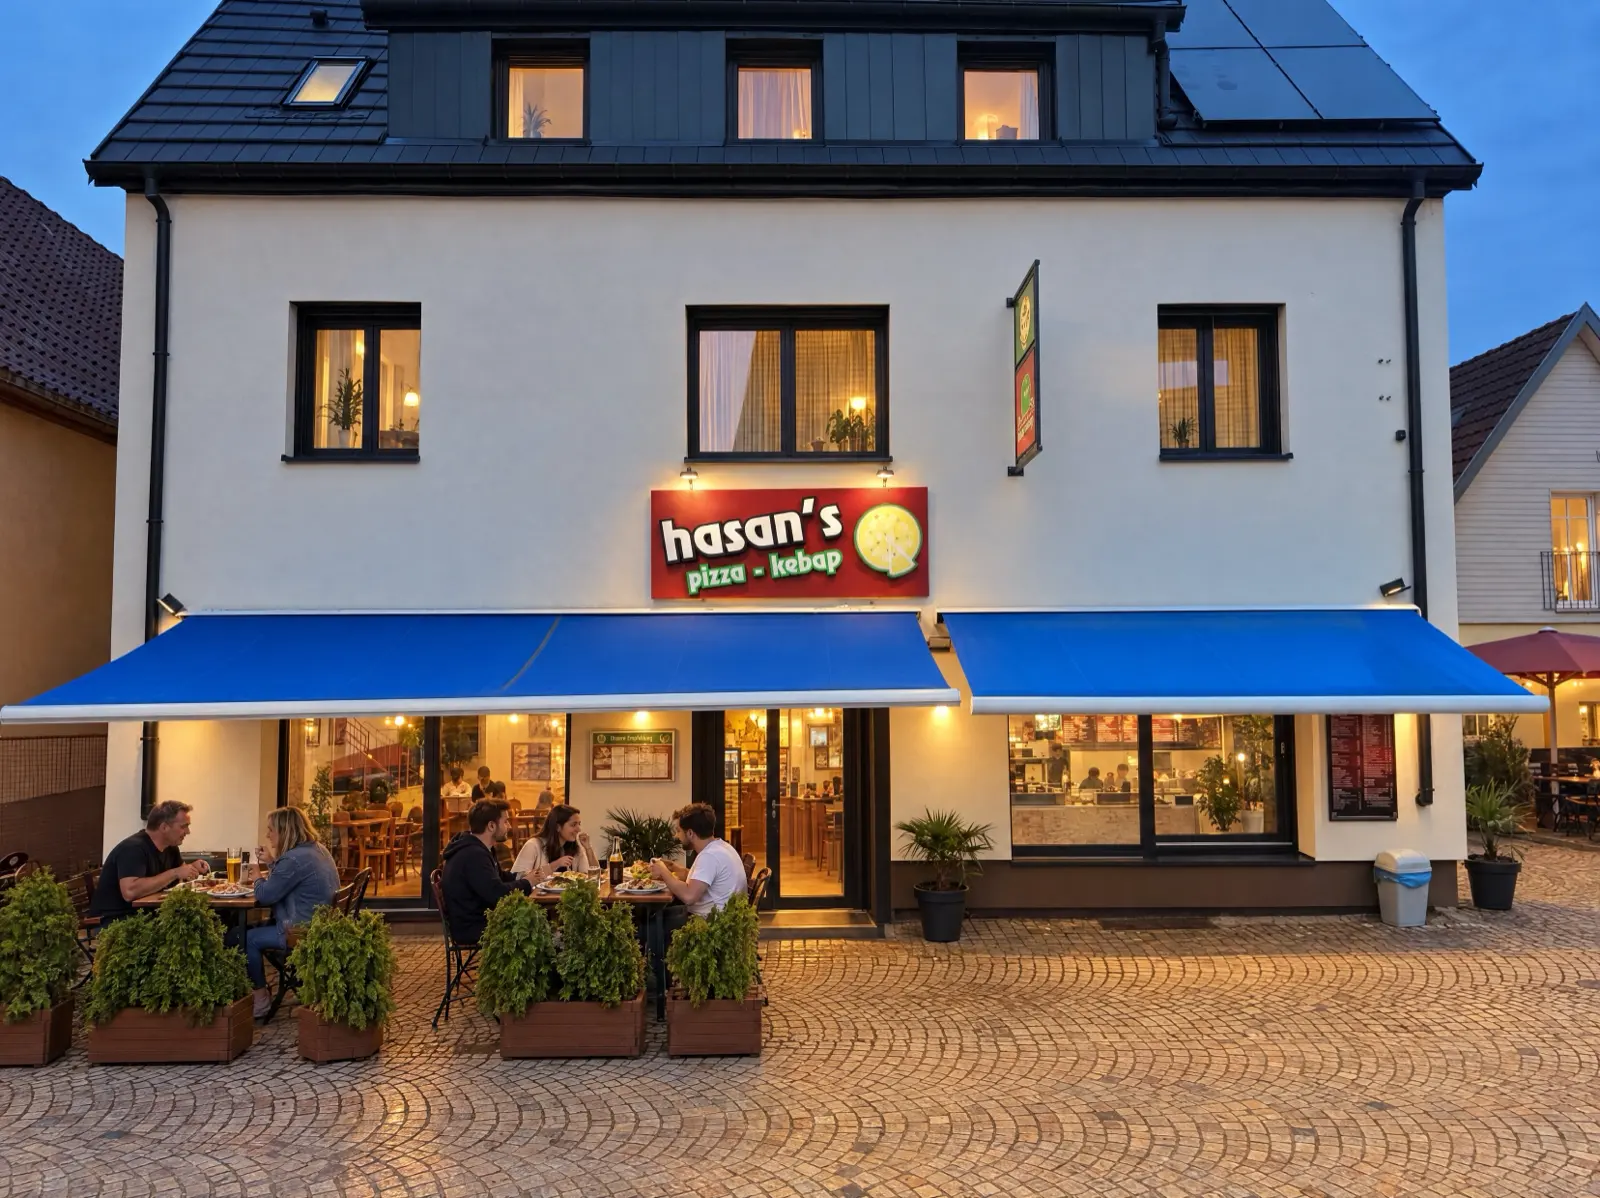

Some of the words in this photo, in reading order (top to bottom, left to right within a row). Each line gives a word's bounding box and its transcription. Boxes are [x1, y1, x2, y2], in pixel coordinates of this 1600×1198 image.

[661, 497, 842, 563] hasan's
[687, 564, 746, 595] pizza
[769, 549, 842, 579] kebap
